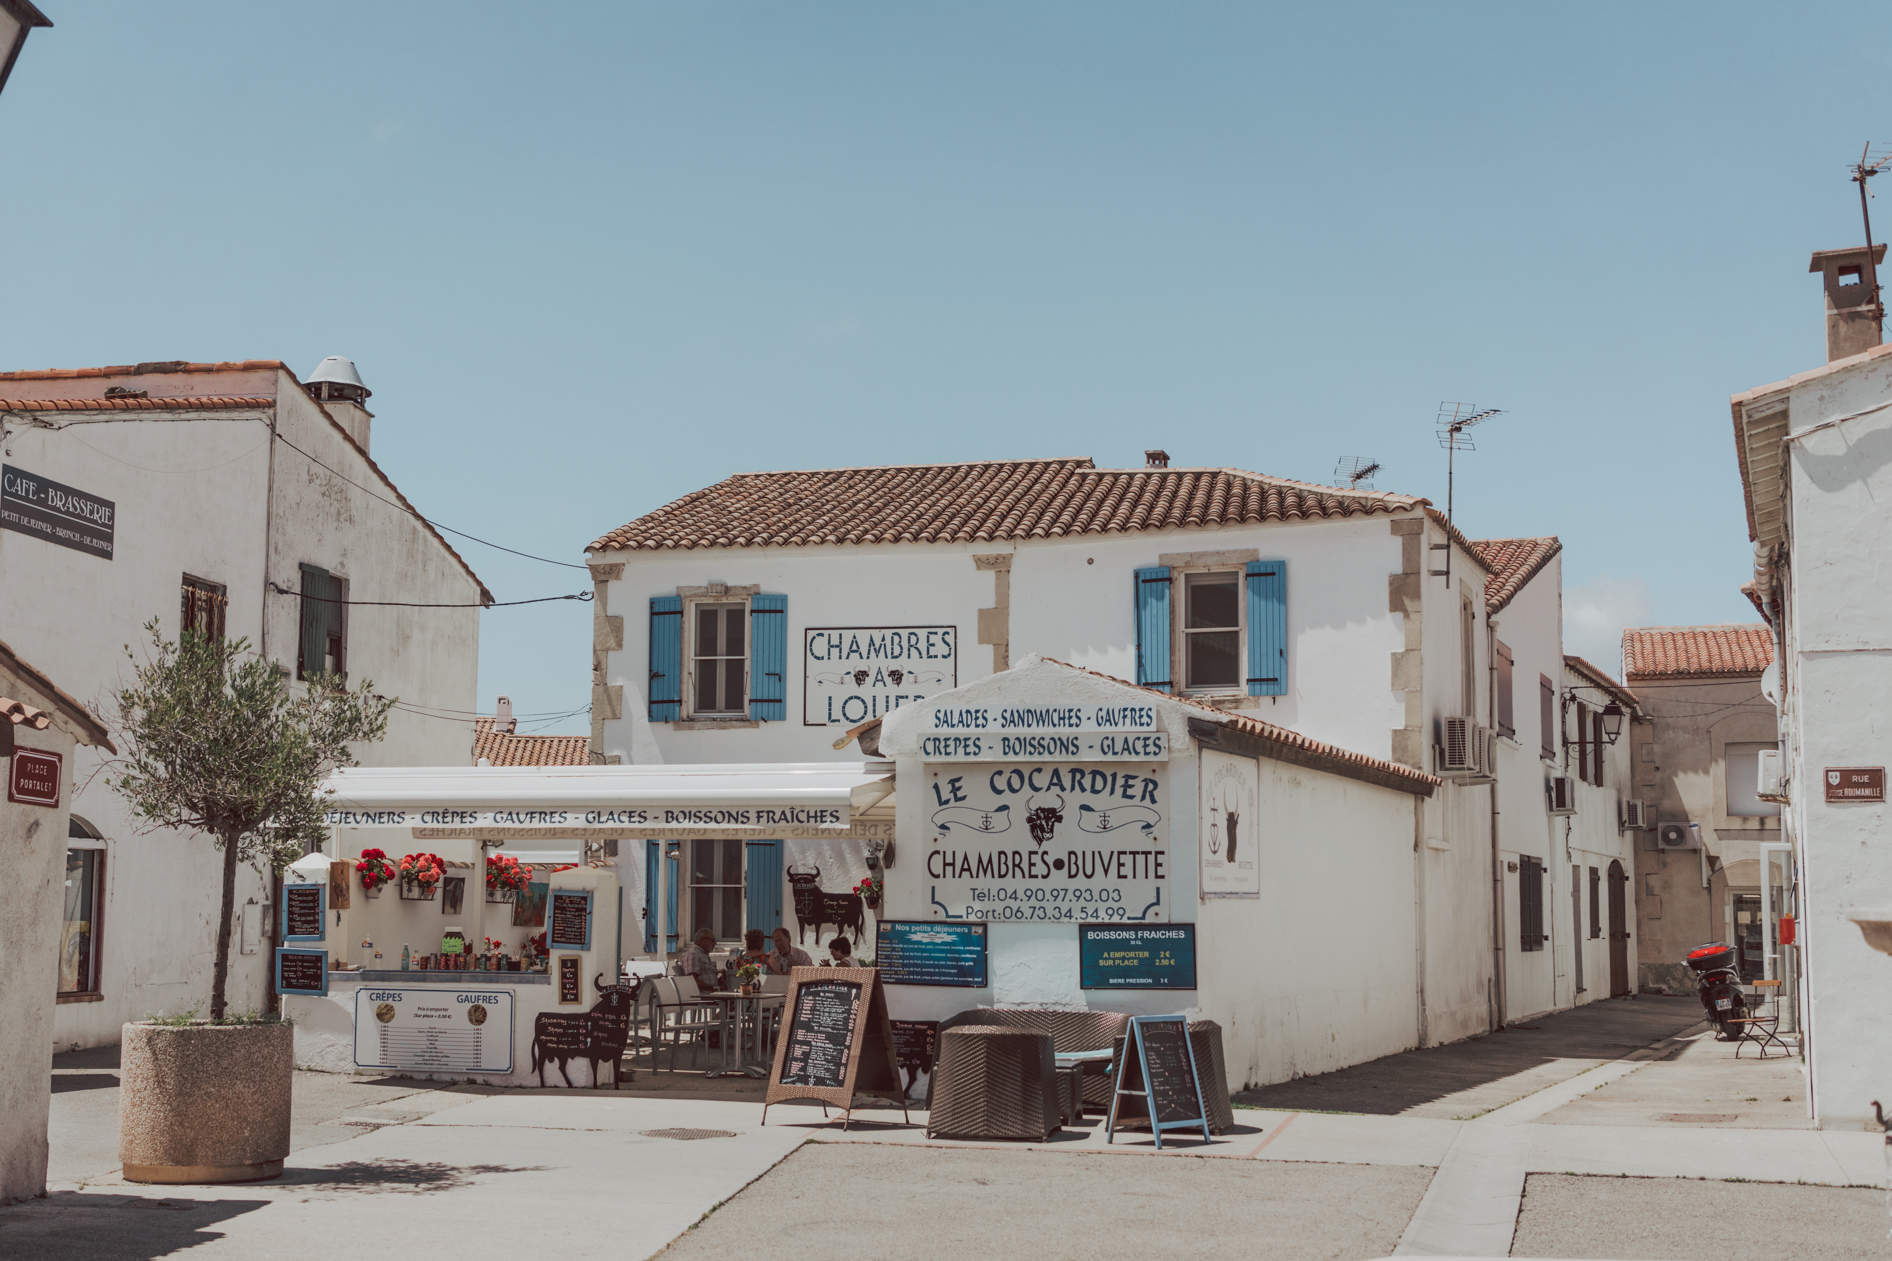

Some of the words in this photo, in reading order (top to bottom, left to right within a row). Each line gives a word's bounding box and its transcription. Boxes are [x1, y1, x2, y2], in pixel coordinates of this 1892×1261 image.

[4, 474, 37, 500] CAFE
[48, 488, 112, 525] BRASSERIE
[1, 510, 20, 522] PETIT
[20, 516, 52, 534] DEJEUNER
[56, 527, 80, 541] BRUNCH
[84, 536, 112, 552] DEJEUNER
[809, 631, 952, 661] CHAMBRES
[872, 666, 887, 687] A
[828, 695, 925, 723] LOU
[934, 708, 988, 728] SALADES
[1001, 708, 1082, 728] SANDWICHES
[923, 736, 982, 756] CREPES
[1001, 736, 1080, 756] BOISSONS
[1100, 736, 1162, 756] GLACES
[27, 763, 47, 775] PLACE
[20, 779, 52, 791] PORTALET
[932, 776, 968, 807] LE
[990, 767, 1159, 805] COCARDIER
[1844, 788, 1881, 796] ROUMANILLE
[324, 808, 406, 824] DÉJEUNERS
[421, 808, 478, 824] CRÊPES
[493, 810, 568, 824] GAUFRES
[585, 810, 648, 824] GLACES
[664, 810, 750, 824] BOISSONS
[755, 807, 840, 824] FRAÎCHES
[927, 850, 1050, 879] CHAMBRES
[1068, 850, 1166, 879] BUVETTE
[933, 925, 968, 933] déjeuners
[1088, 931, 1135, 939] BOISSONS
[1138, 930, 1185, 939] FRAICHES
[370, 992, 403, 1002] CRÊPES
[456, 995, 499, 1004] GAUFRES
